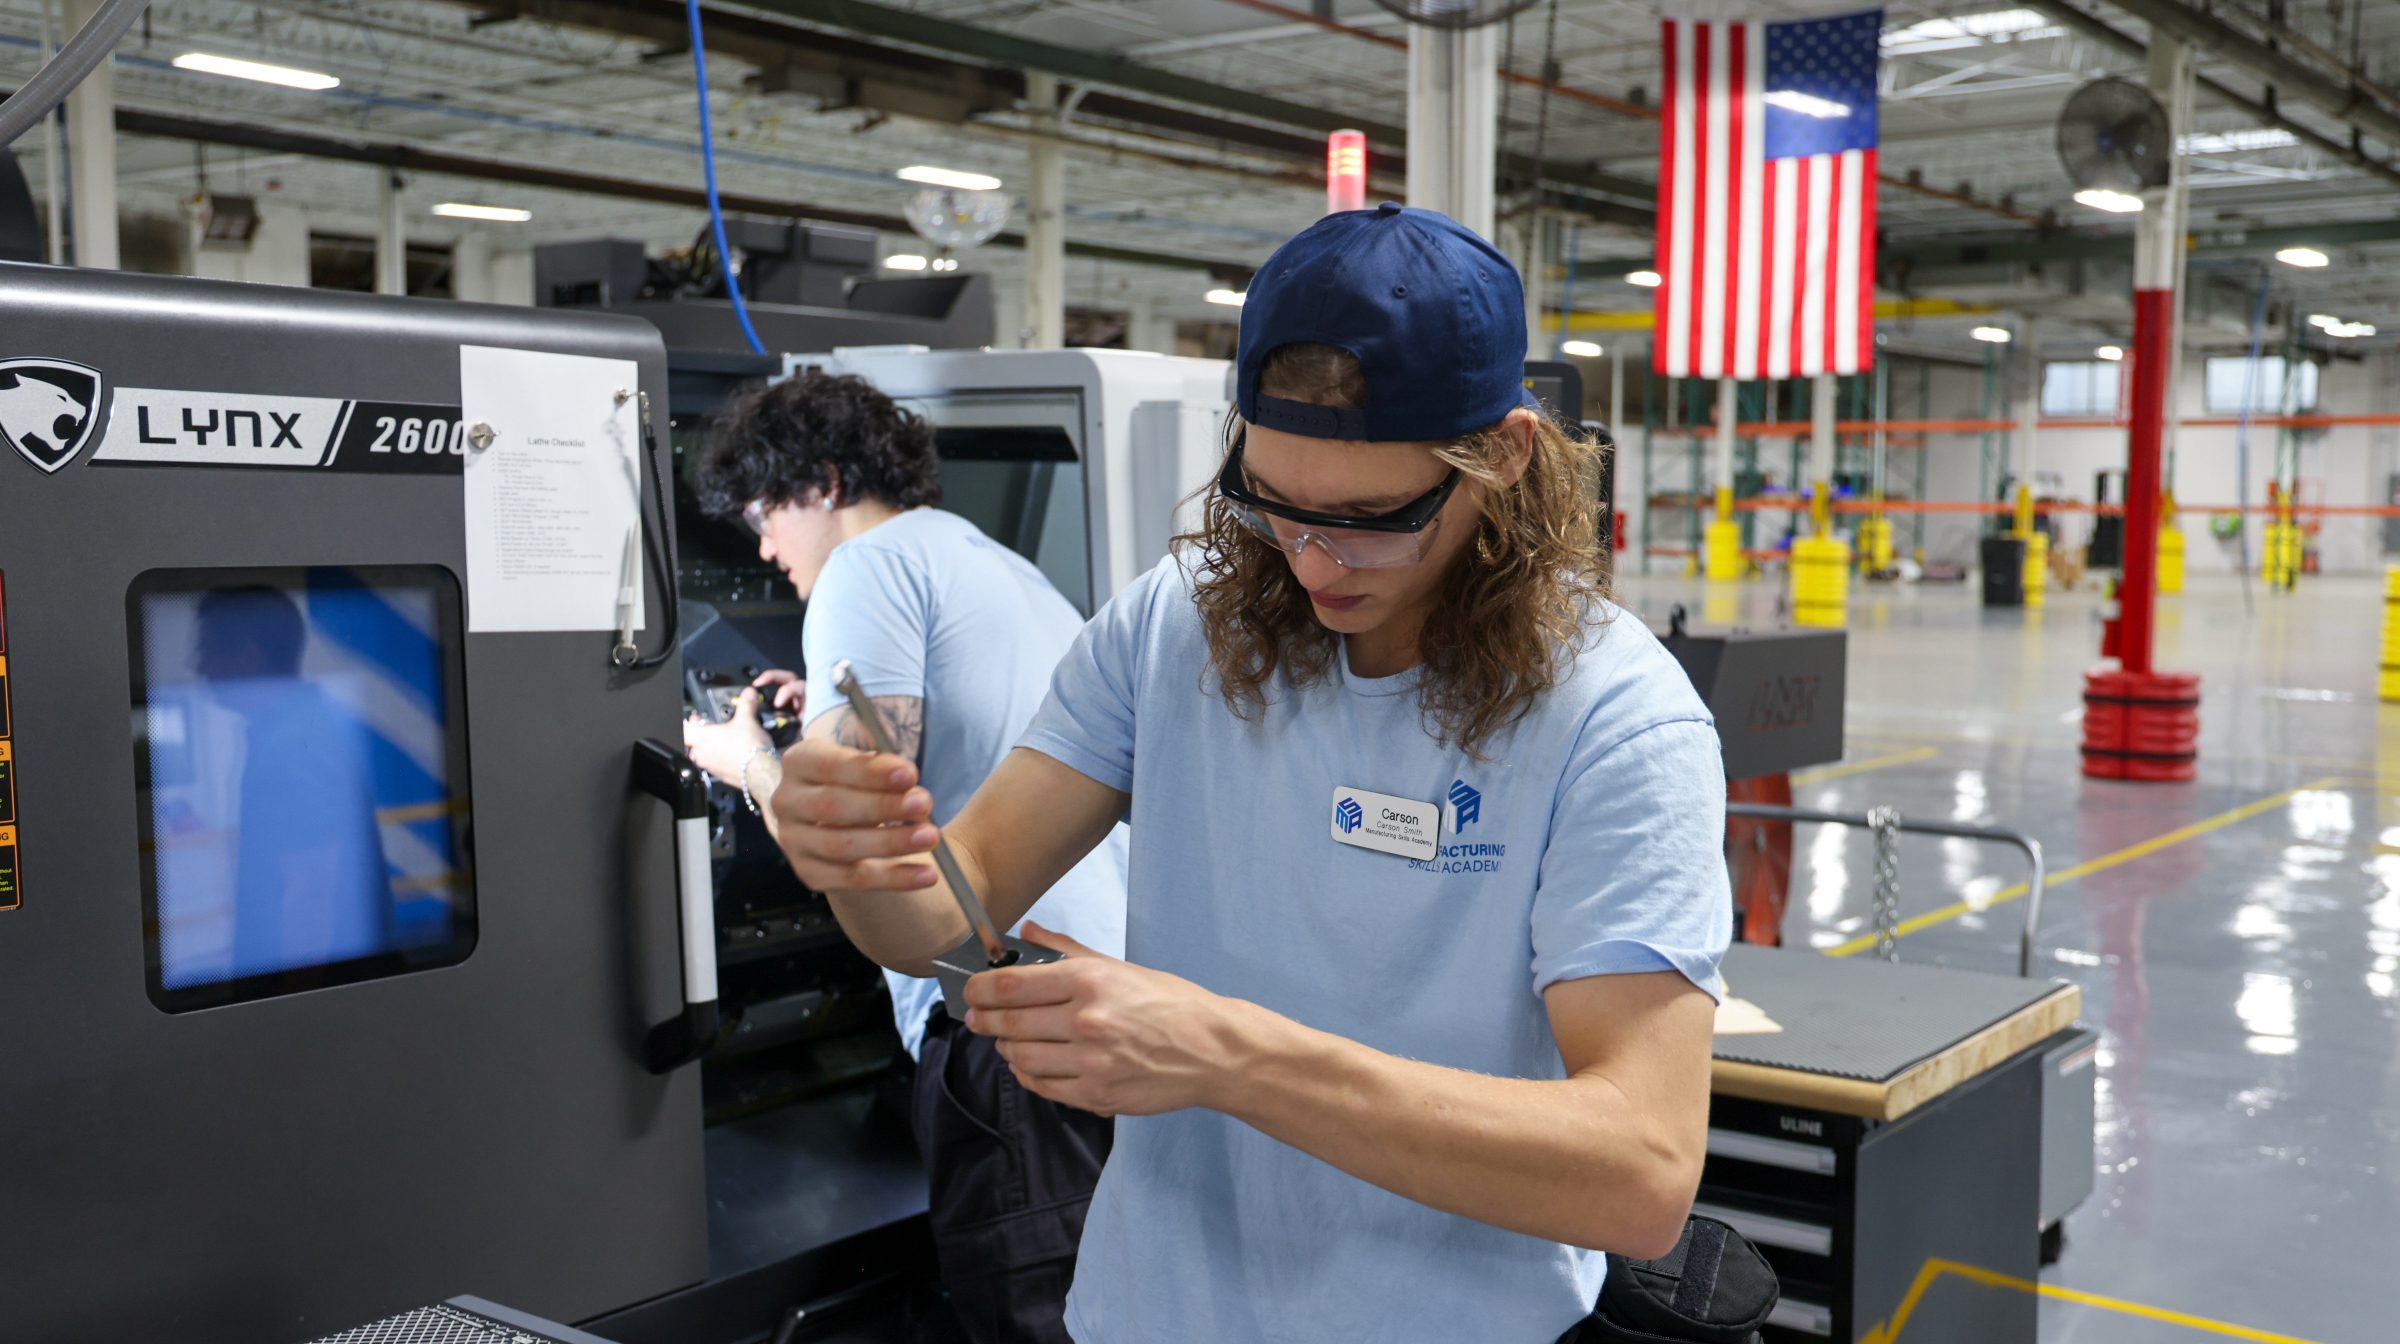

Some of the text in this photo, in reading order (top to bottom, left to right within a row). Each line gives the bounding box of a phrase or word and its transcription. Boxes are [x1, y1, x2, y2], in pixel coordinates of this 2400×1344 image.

[137, 405, 303, 449] LYNX
[527, 437, 585, 448] Lathe Checklist
[1381, 808, 1419, 826] Carson
[1376, 820, 1423, 837] Carson Smith
[1365, 827, 1433, 848] Manufacturing Skills Academy
[1439, 843, 1506, 859] ACTURING
[1441, 859, 1501, 874] ACADEM
[1780, 1115, 1823, 1137] ULINE
